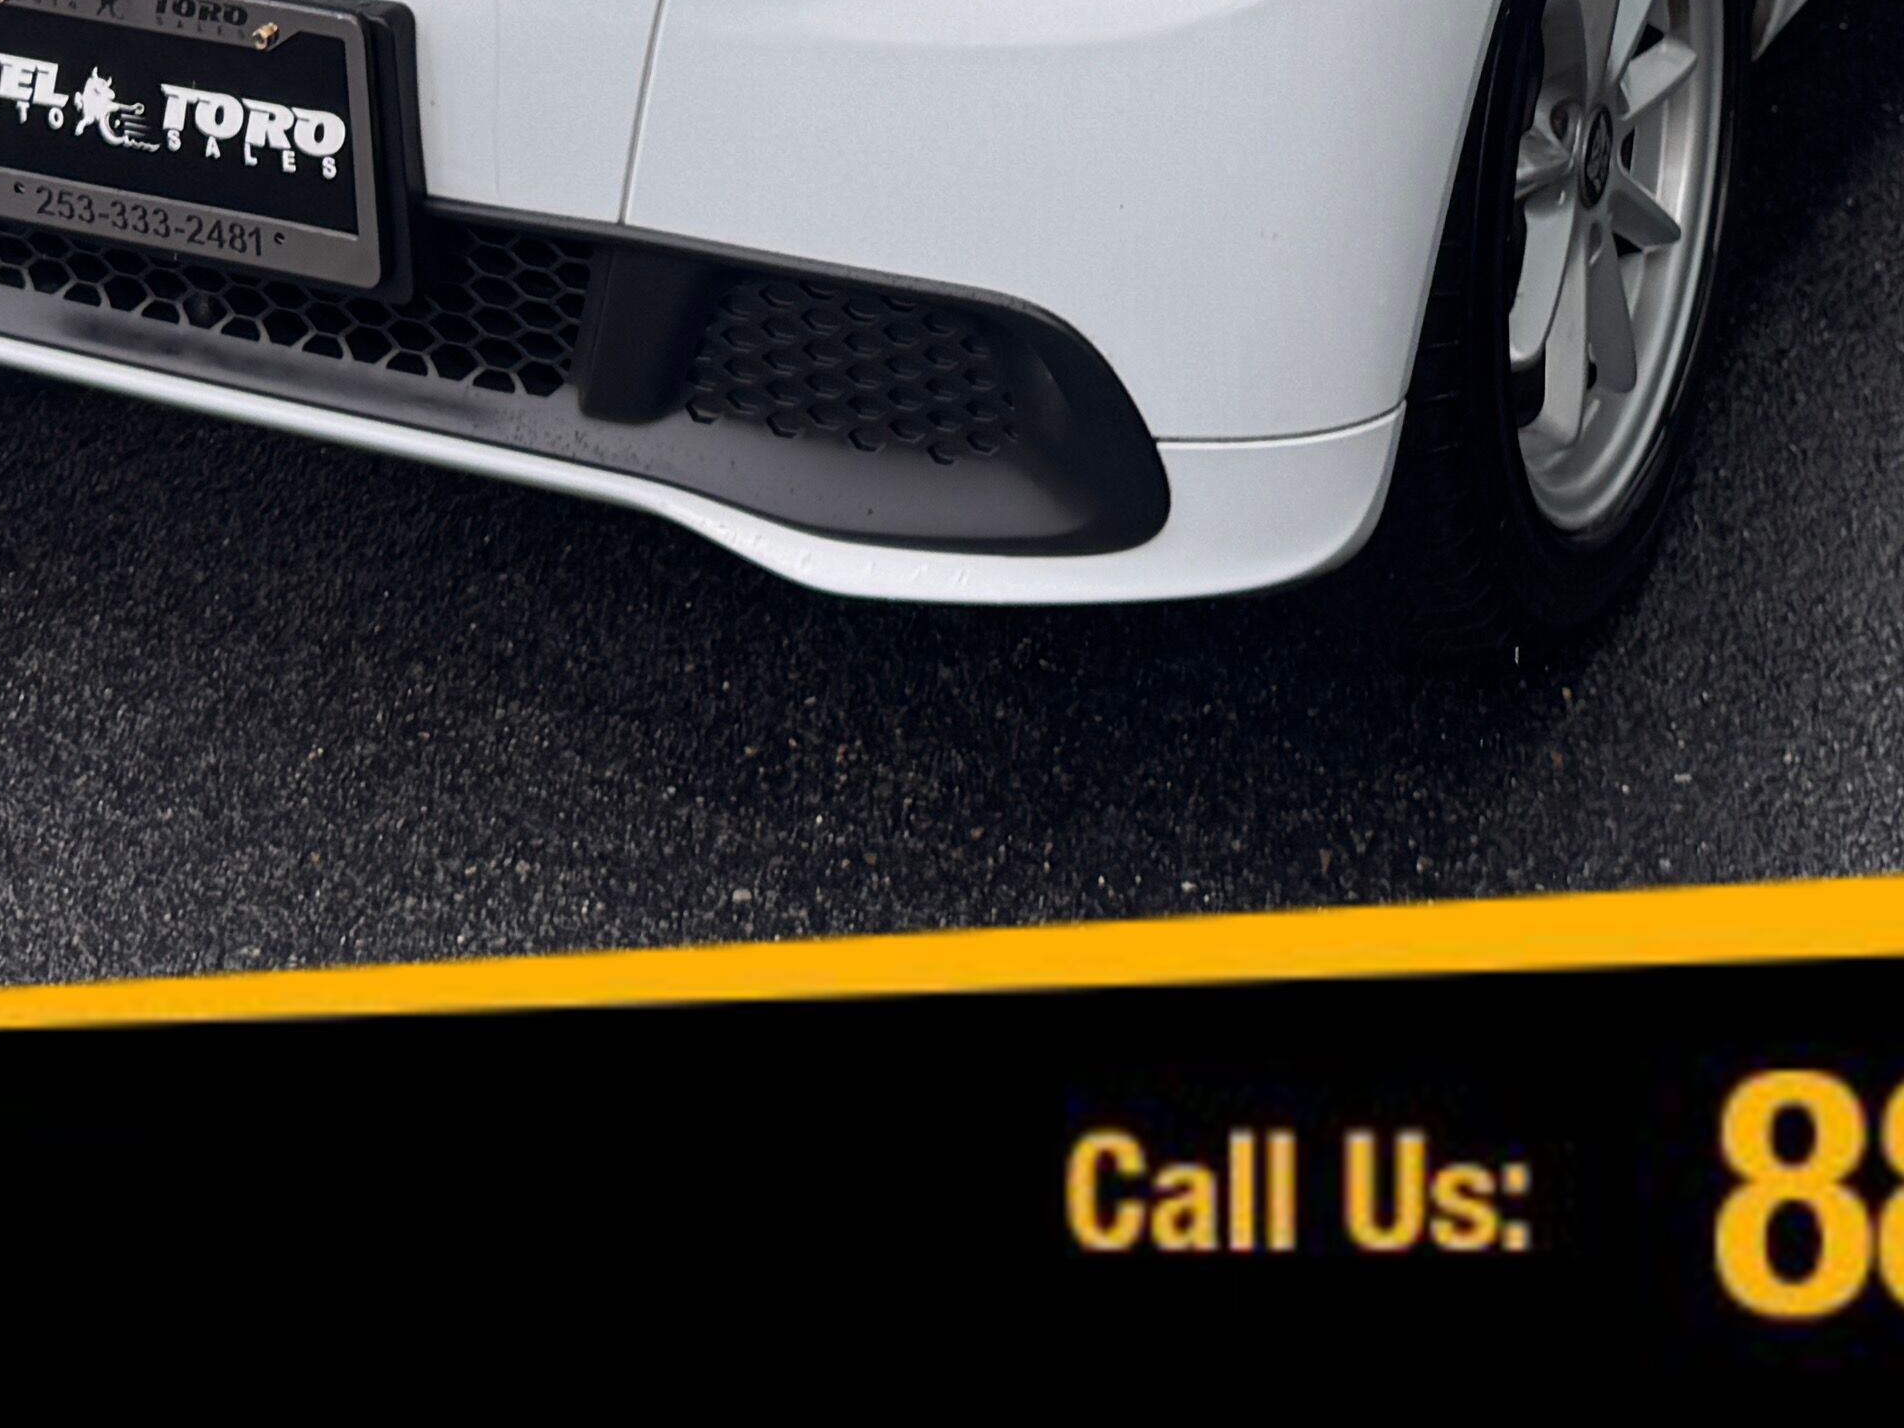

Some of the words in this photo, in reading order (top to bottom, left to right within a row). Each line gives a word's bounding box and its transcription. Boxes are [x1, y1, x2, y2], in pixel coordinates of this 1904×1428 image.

[160, 82, 346, 158] TORO
[166, 129, 338, 180] SALES
[35, 186, 264, 259] 253-333-2481
